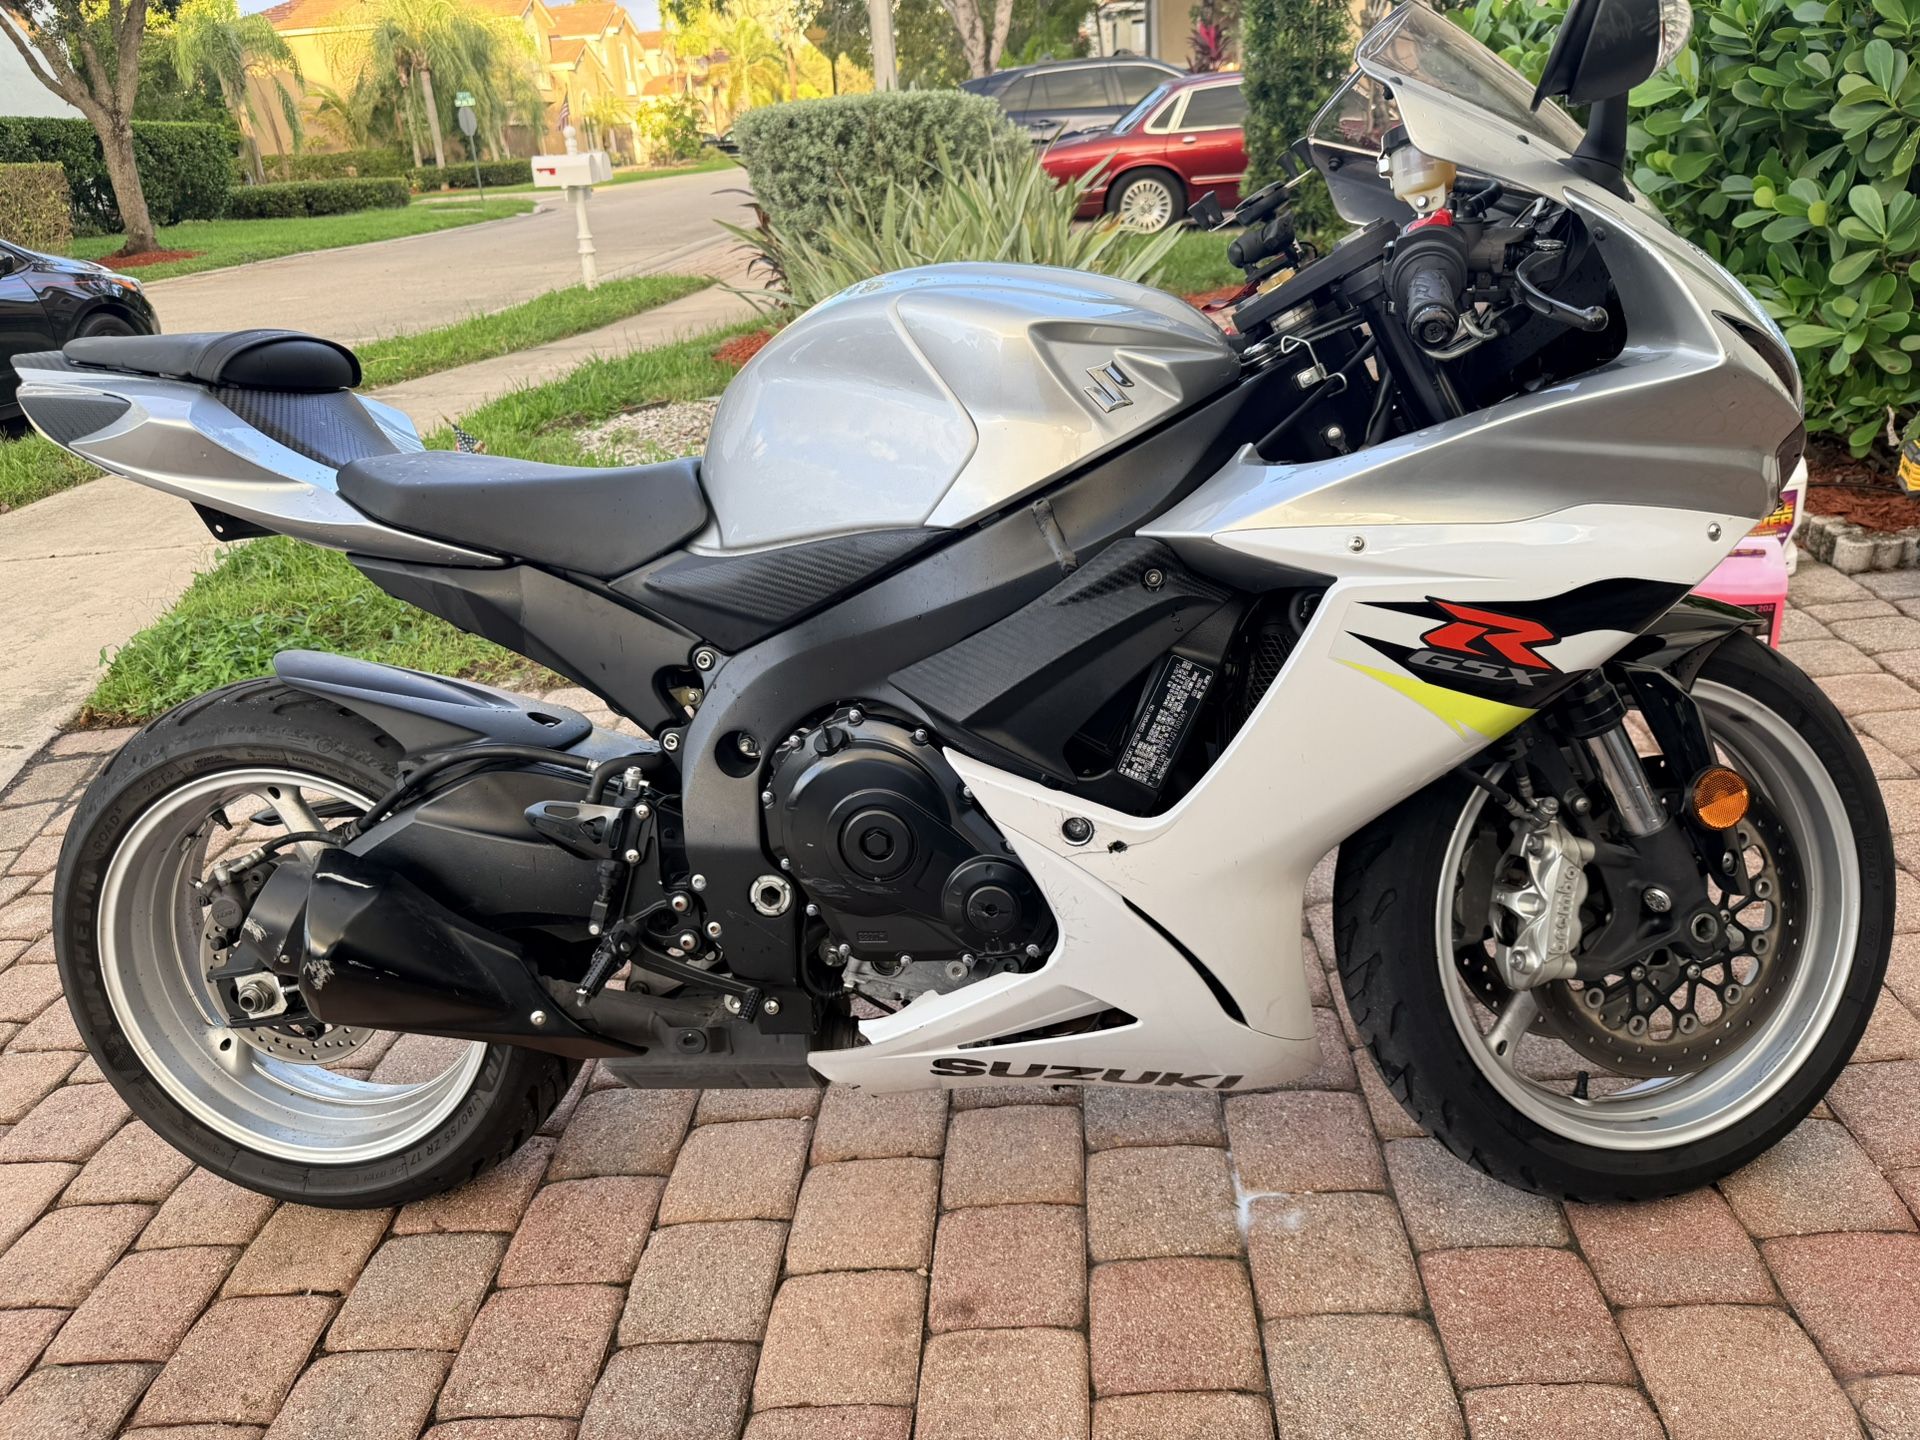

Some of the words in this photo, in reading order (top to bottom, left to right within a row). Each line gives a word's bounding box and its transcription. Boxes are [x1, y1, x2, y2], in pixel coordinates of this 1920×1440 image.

[1423, 599, 1554, 671] R
[1407, 650, 1549, 687] GSX
[1131, 732, 1141, 746] MOTOR
[1138, 703, 1155, 732] CORPORATION
[73, 868, 112, 1026] MICHELIN
[94, 814, 121, 849] ROAD
[1548, 865, 1578, 955] brembo
[929, 1057, 1245, 1089] SUZUKI
[444, 1101, 477, 1139] 180/55
[410, 1151, 422, 1165] 17
[426, 1139, 441, 1156] ZR
